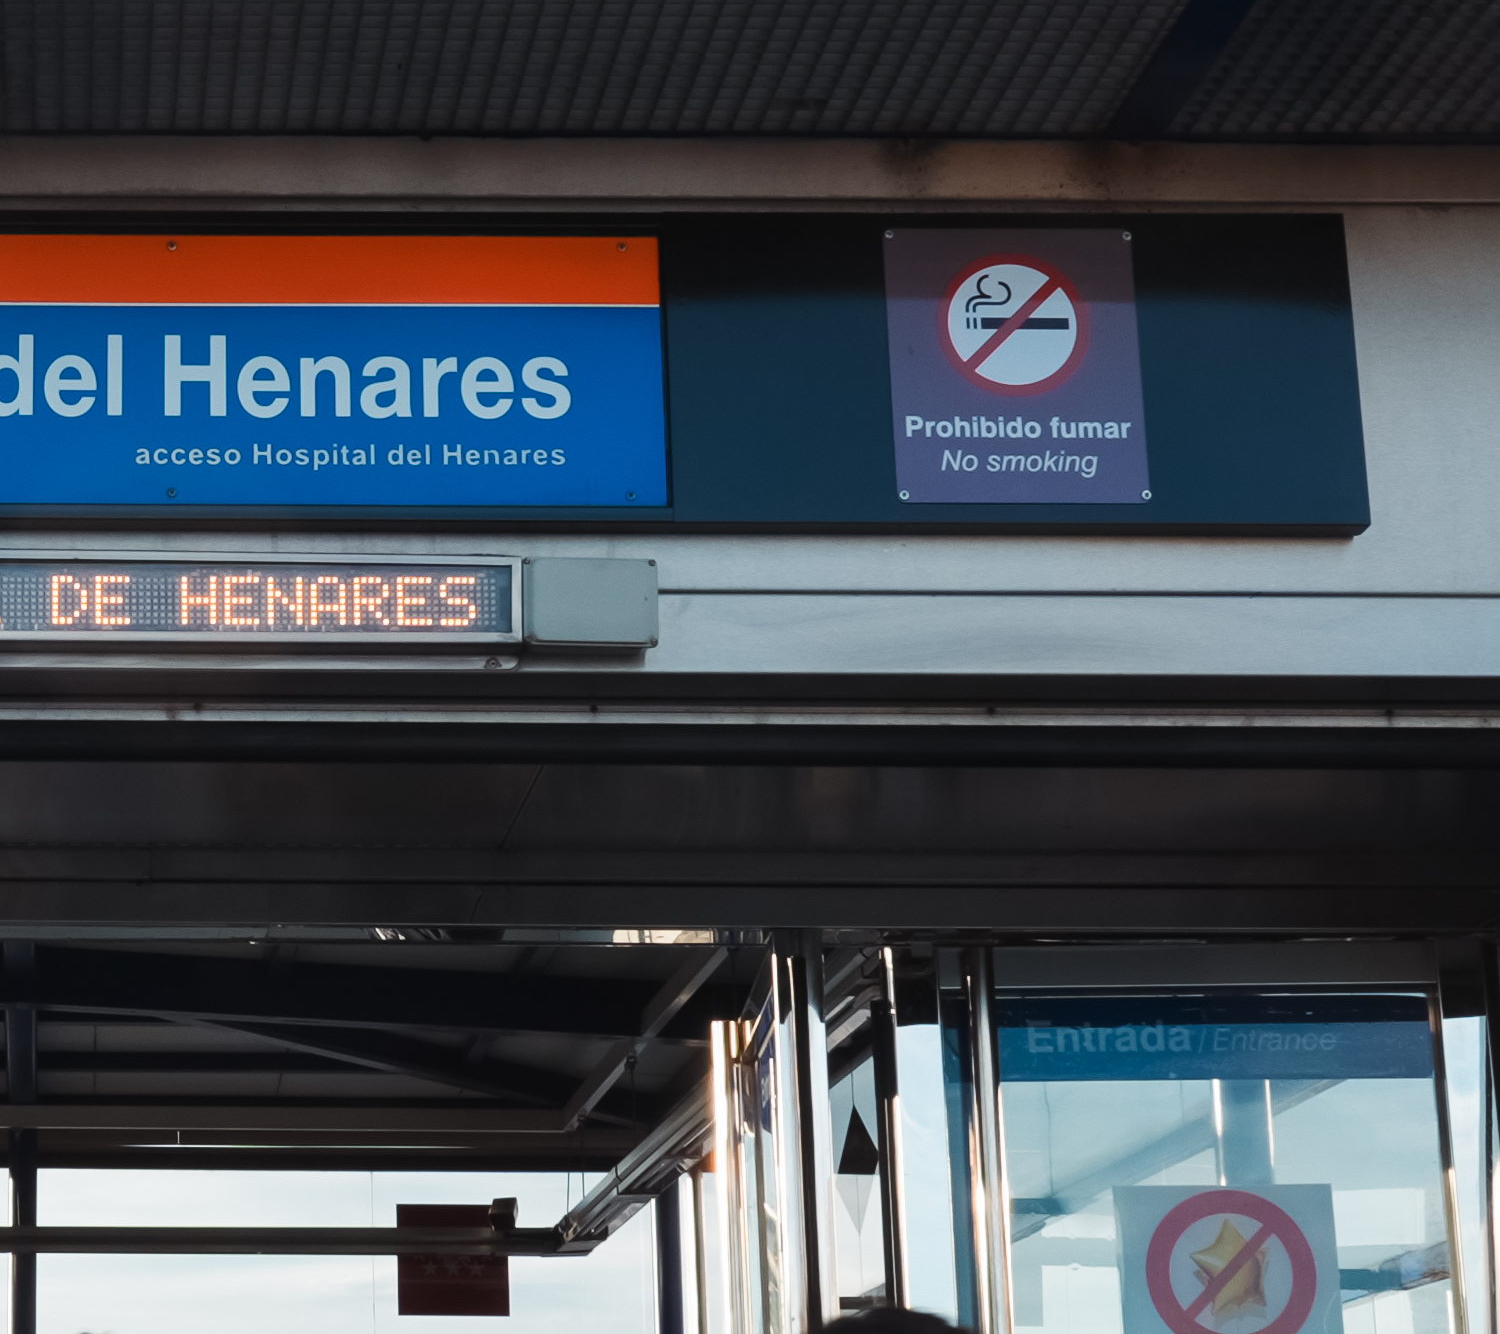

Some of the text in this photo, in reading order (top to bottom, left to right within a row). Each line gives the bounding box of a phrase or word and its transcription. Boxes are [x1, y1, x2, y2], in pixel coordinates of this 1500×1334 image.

[164, 334, 572, 419] Henares
[905, 415, 1131, 439] Prohibido fumar
[135, 443, 566, 470] acceso Hospital del Henares
[941, 449, 1098, 479] No smoking
[51, 575, 132, 627] DE
[179, 576, 477, 627] HENARES
[1027, 1021, 1192, 1054] Entrada
[1212, 1027, 1337, 1053] Entrance
